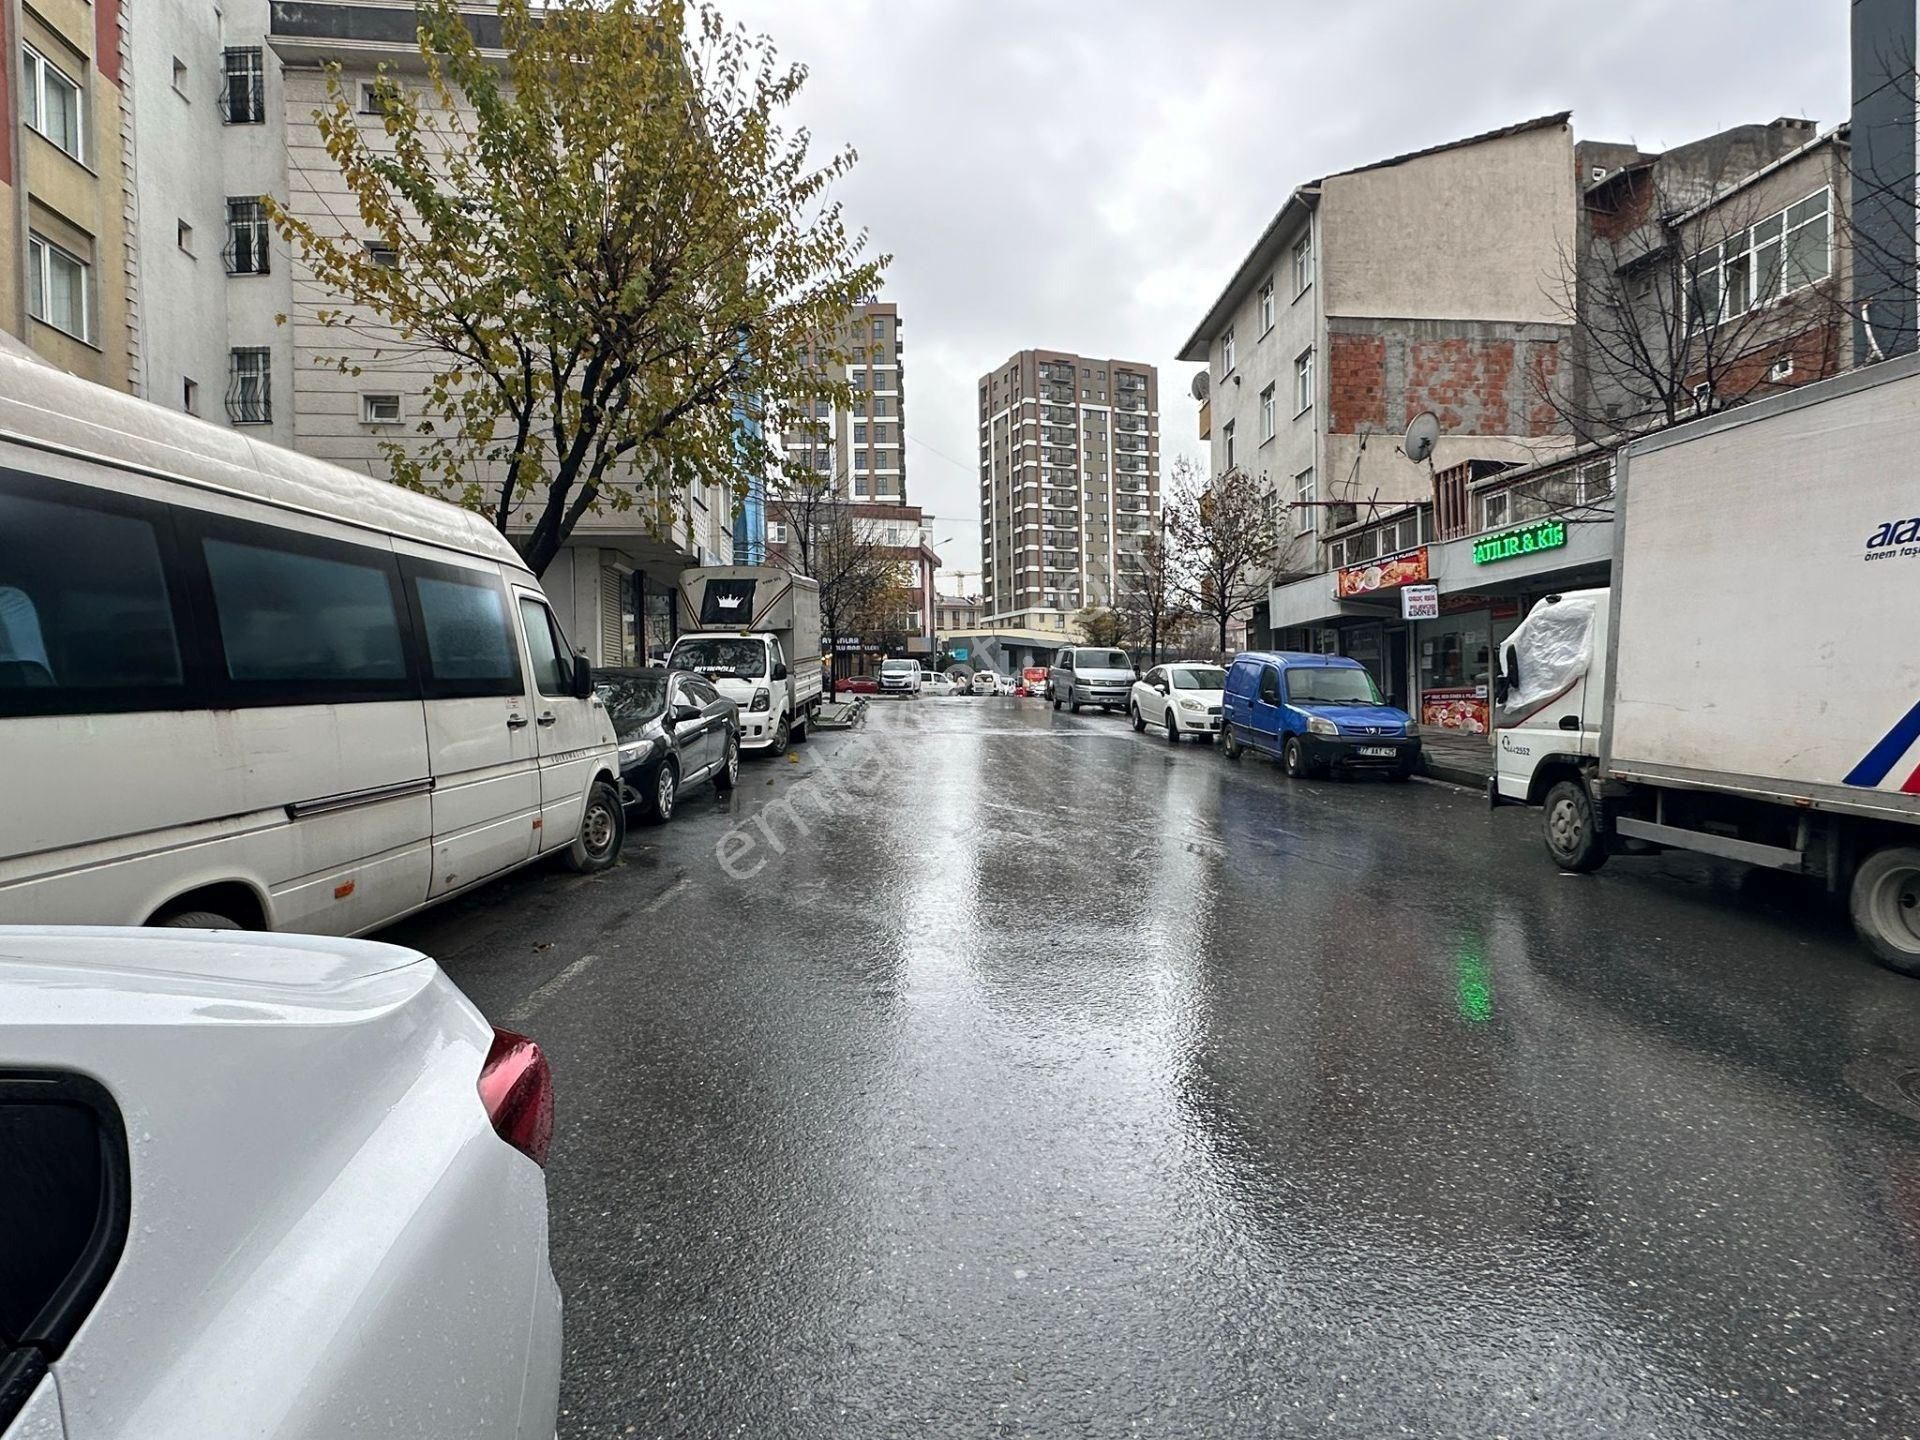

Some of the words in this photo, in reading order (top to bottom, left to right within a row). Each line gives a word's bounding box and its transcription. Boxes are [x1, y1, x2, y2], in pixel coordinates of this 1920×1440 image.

[1523, 533, 1534, 551] &
[1866, 518, 1920, 548] ara
[1864, 550, 1896, 561] önem
